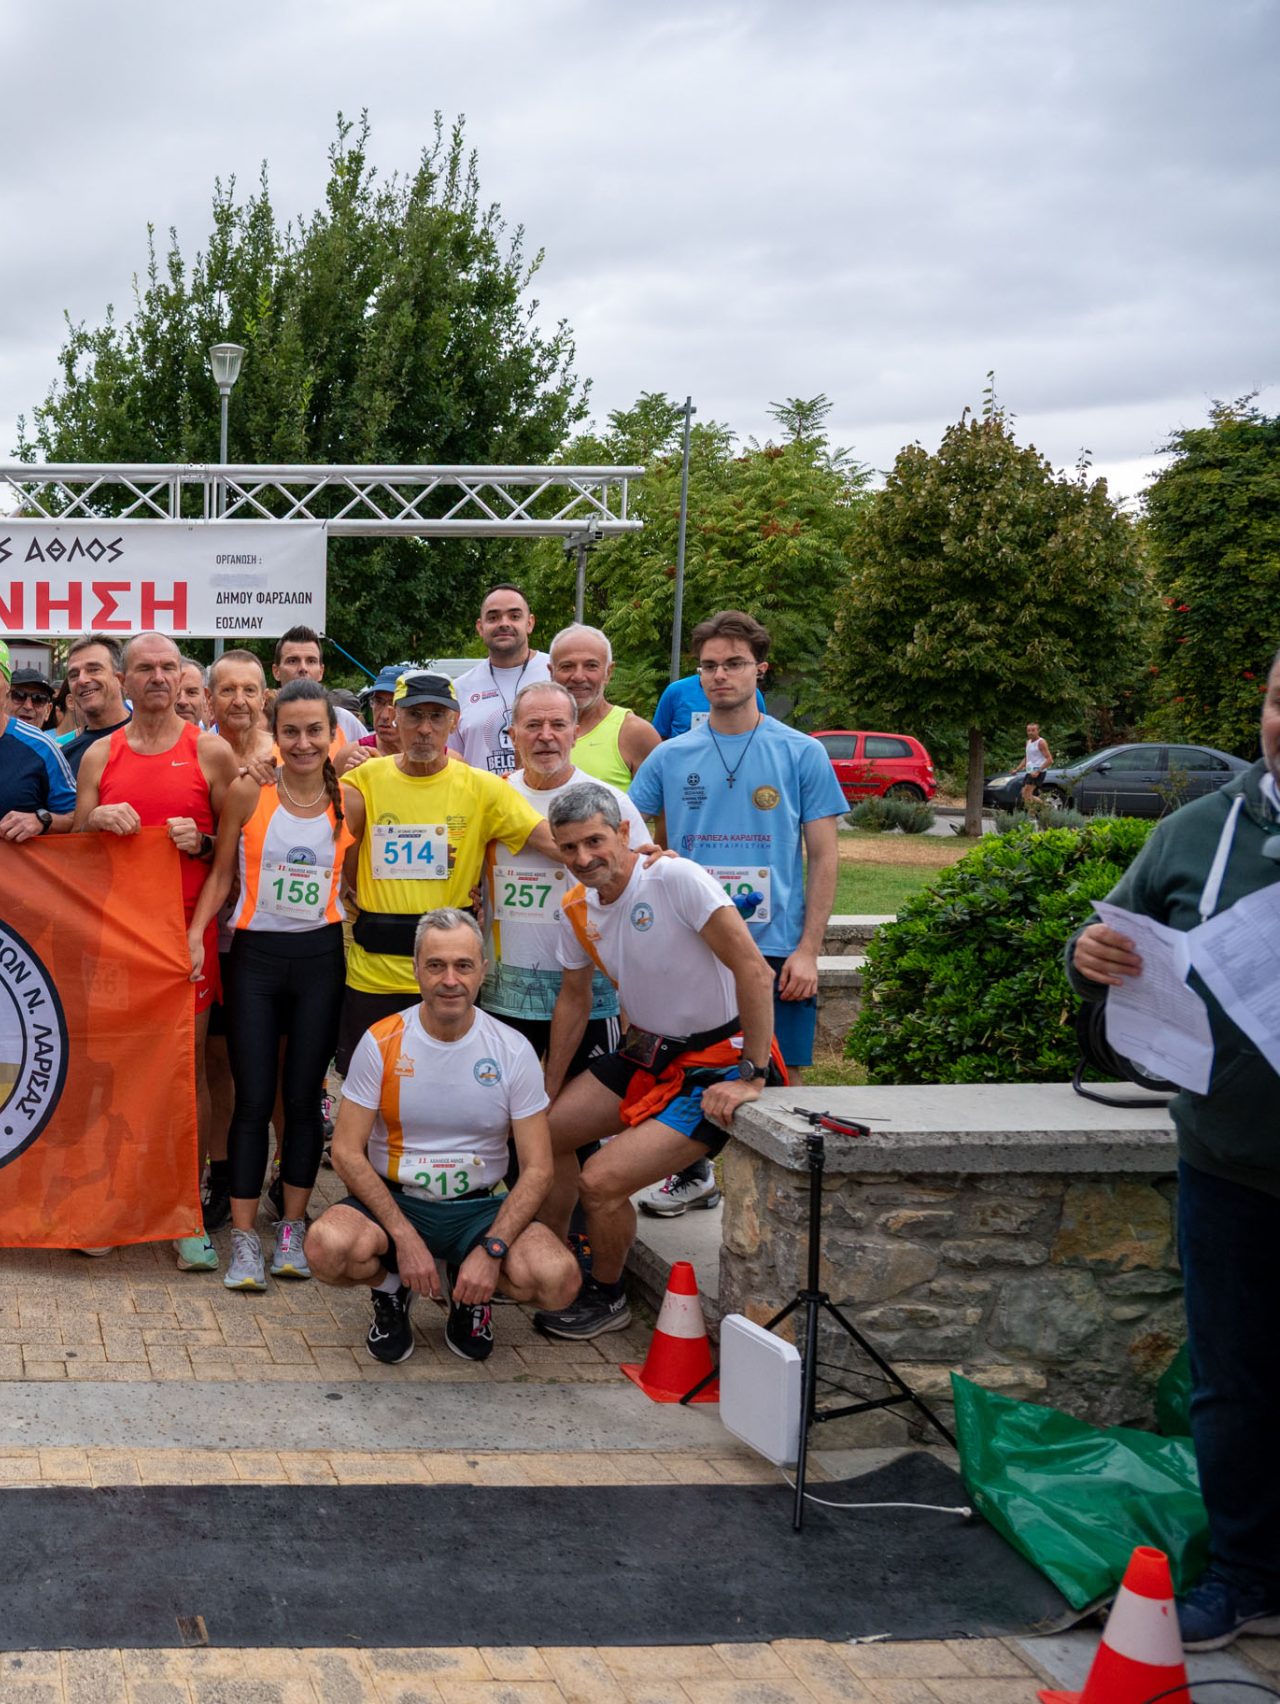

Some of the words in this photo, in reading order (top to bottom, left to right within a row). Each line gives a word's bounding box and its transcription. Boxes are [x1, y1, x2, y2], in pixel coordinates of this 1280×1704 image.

[24, 536, 125, 563] ΑΘΛΟΣ
[216, 554, 257, 565] ΟΡΓΑΝΩΣΗ
[216, 592, 253, 604] ΔΗΜΟΥ
[256, 591, 312, 605] ΦΑΡΣΑΛΩΝ
[216, 617, 263, 629] ΕΟΣΛΜΑΥ
[487, 755, 515, 771] BELG
[384, 840, 434, 865] 514
[272, 877, 320, 906] 158
[503, 882, 553, 909] 257
[16, 1024, 54, 1120] ΛΑΡΙΣΑΣ
[415, 1171, 469, 1196] 213
